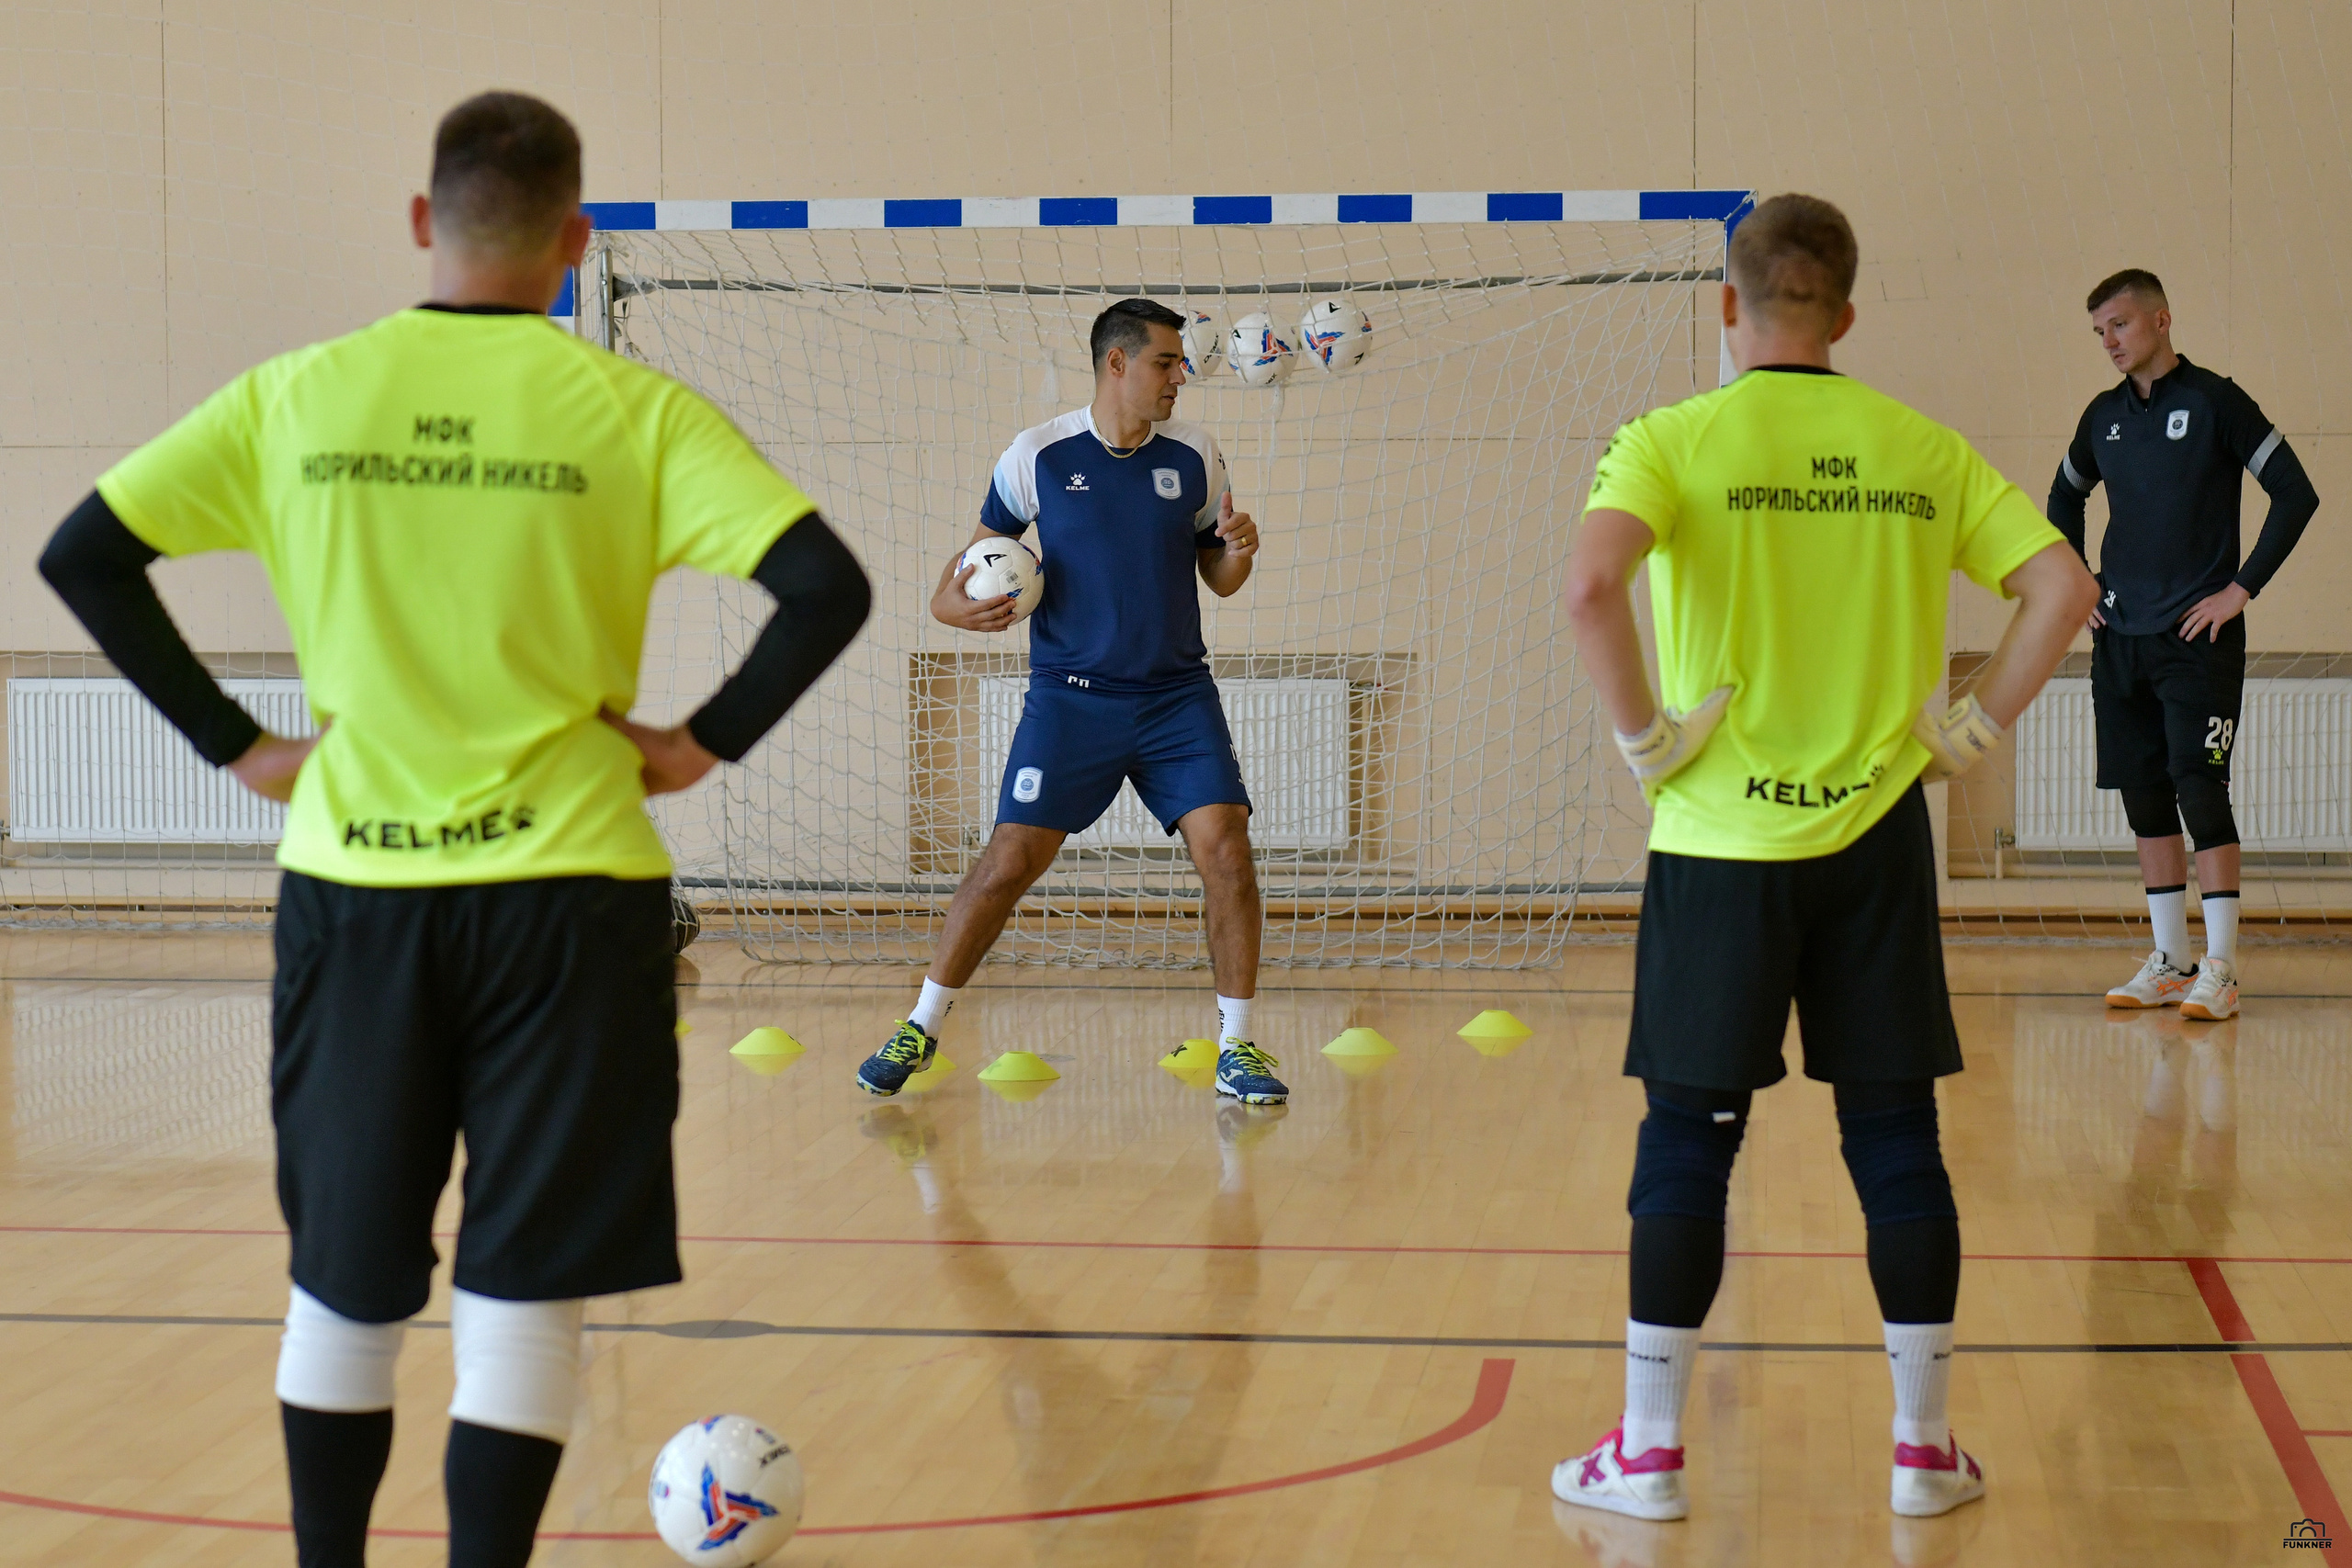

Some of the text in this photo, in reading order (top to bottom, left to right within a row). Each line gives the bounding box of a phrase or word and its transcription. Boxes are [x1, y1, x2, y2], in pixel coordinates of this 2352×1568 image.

[301, 452, 588, 494] НОРИЛЬСКИЙ НИКЕЛЬ
[1811, 456, 1858, 479] МФК
[1727, 485, 1937, 521] НОРИЛЬСКИЙ НИКЕЛЬ
[2204, 716, 2233, 751] 28
[1746, 776, 1871, 808] KELM
[345, 809, 505, 849] KELME
